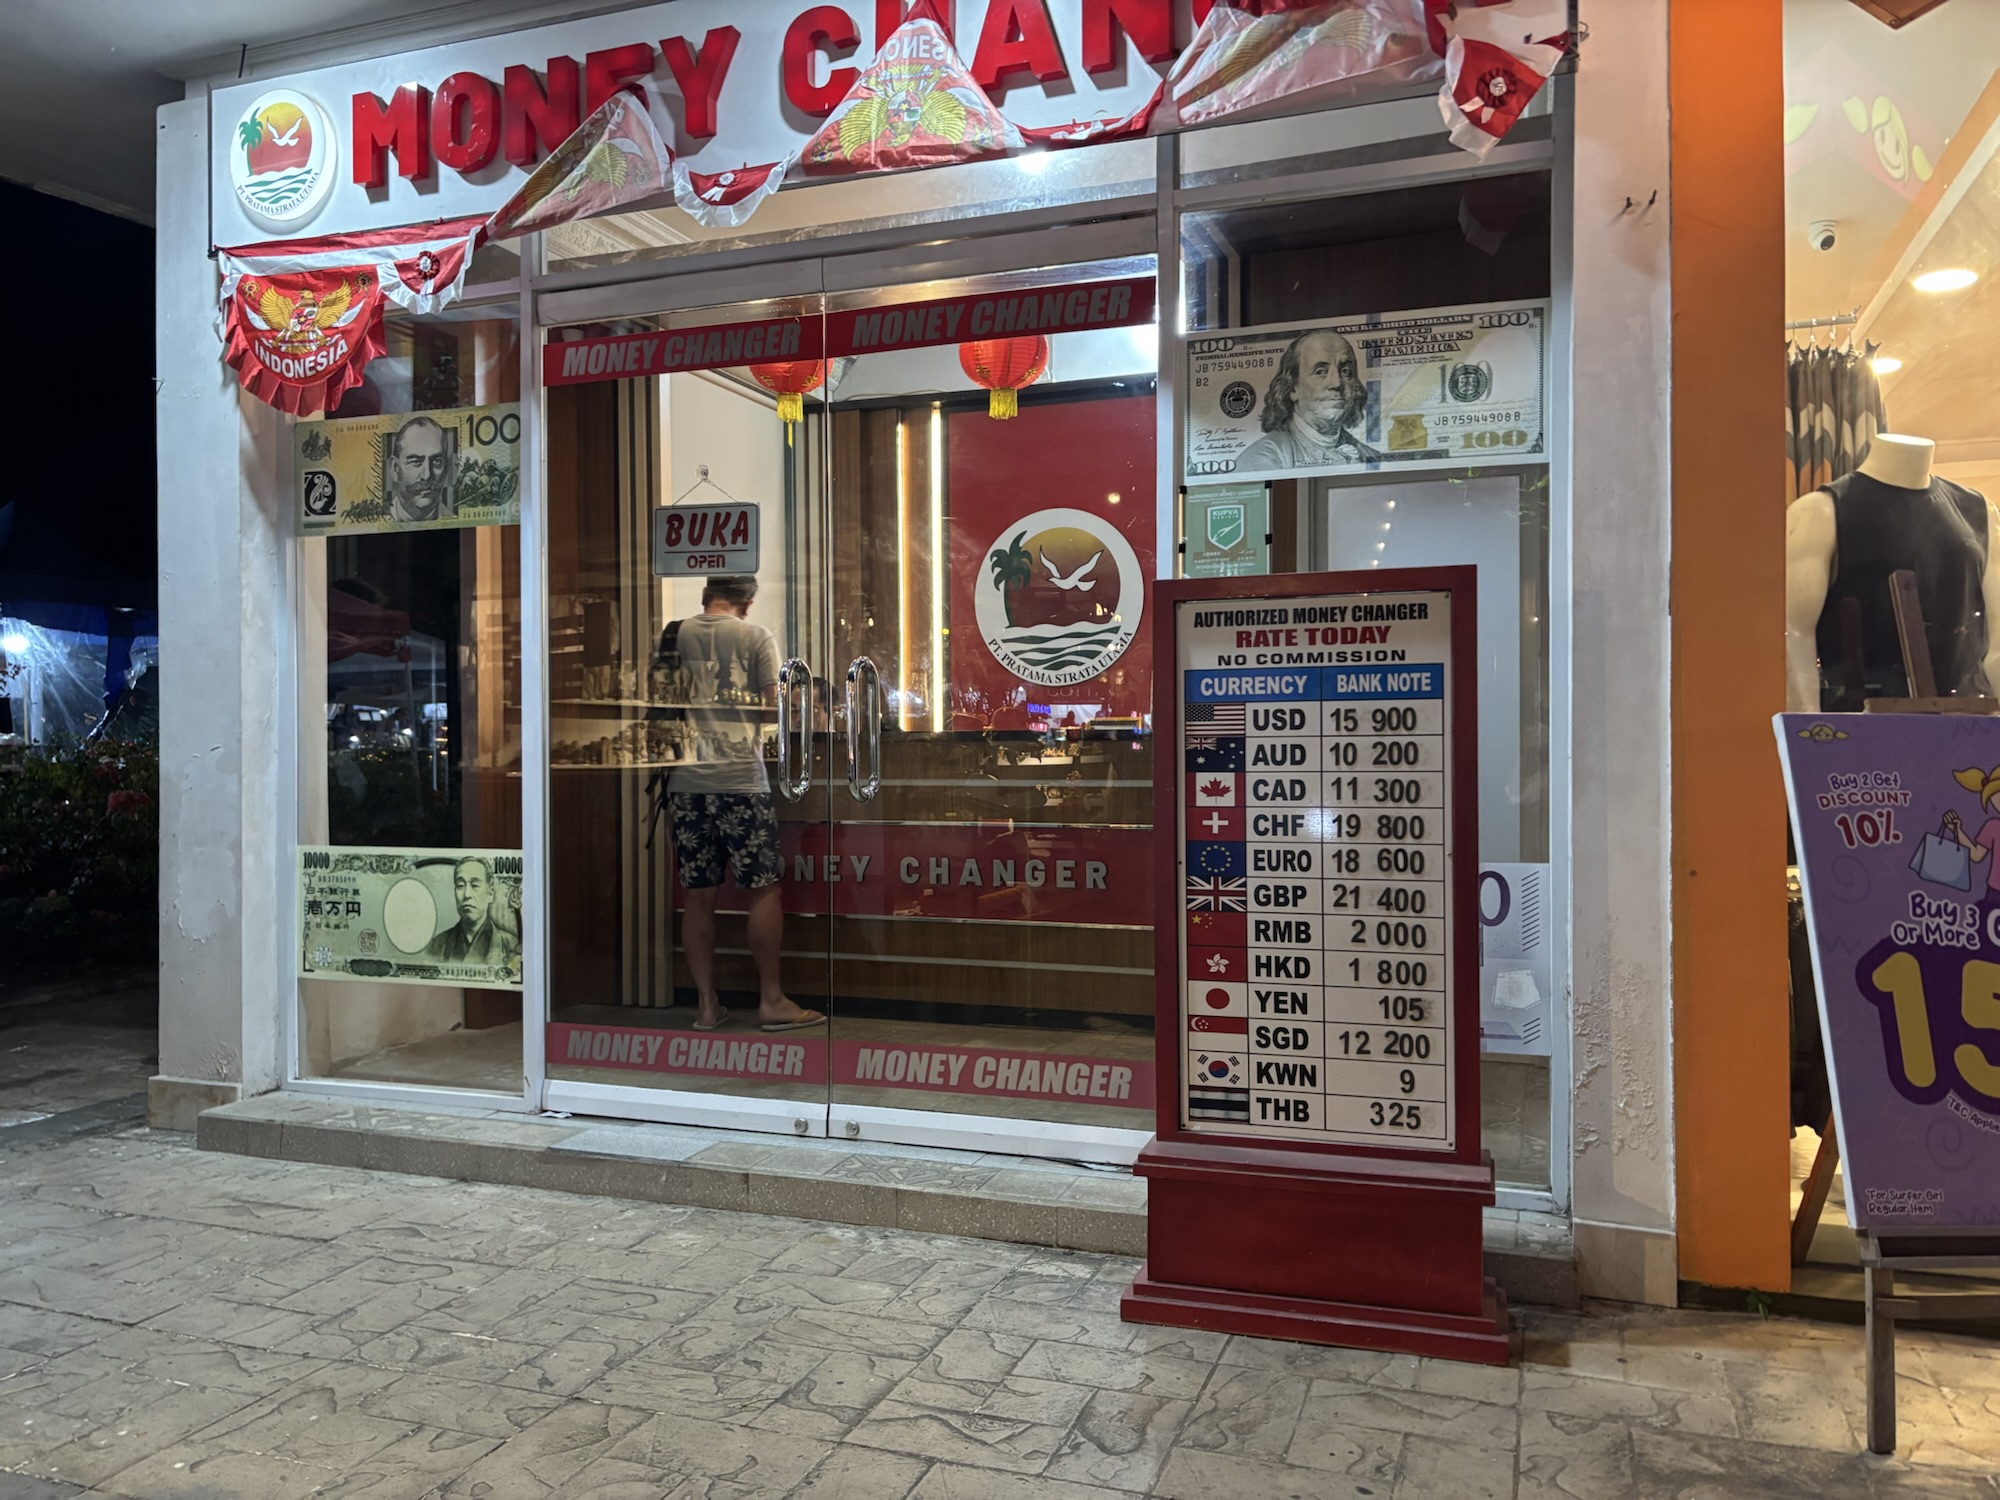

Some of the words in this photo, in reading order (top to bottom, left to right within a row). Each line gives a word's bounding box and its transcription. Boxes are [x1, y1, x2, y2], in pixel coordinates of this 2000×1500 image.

[245, 195, 275, 214] PRATAMA
[275, 198, 301, 214] STRATA
[300, 171, 320, 200] UTAMA
[852, 303, 962, 348] MONEY
[967, 285, 1132, 336] CHANGER
[1479, 312, 1529, 329] 100
[1192, 338, 1235, 354] 100
[1414, 330, 1473, 344] STATES
[254, 338, 348, 379] INDONESIA
[562, 338, 655, 378] MONEY
[663, 323, 800, 368] CHANGER
[1195, 363, 1209, 373] JB
[1211, 358, 1265, 372] 75944908
[1267, 358, 1274, 366] B
[1196, 377, 1209, 387] B2
[466, 413, 520, 447] 100
[1434, 415, 1449, 426] JB
[1451, 412, 1511, 425] 75944908
[1514, 411, 1521, 420] B
[1461, 429, 1528, 450] 100
[1195, 459, 1237, 474] 100
[665, 510, 749, 548] BUKA
[687, 554, 726, 569] OPEN
[1193, 608, 1289, 628] AUTHORIZED
[1293, 605, 1348, 624] MONEY
[1351, 603, 1429, 622] CHANGER
[1236, 629, 1298, 649] RATE
[1304, 625, 1392, 646] TODAY
[988, 638, 1002, 657] PT.
[1001, 655, 1052, 684] PRATAMA
[1055, 664, 1100, 684] STRATA
[1098, 631, 1133, 668] UTAMA
[1218, 654, 1247, 666] NO
[1256, 650, 1406, 665] COMMISSION
[1200, 675, 1308, 696] CURRENCY
[1337, 673, 1382, 693] BANK
[1386, 672, 1432, 692] NOTE
[1252, 708, 1306, 731] USD
[1329, 707, 1358, 732] 15
[1371, 706, 1417, 732] 900
[1252, 744, 1306, 767] AUD
[1329, 742, 1357, 766] 10
[1372, 741, 1419, 765] 200
[1252, 779, 1306, 801] CAD
[1330, 777, 1358, 800] 11
[1374, 778, 1421, 803] 300
[1830, 774, 1858, 790] Buy
[1862, 773, 1870, 786] 2
[1873, 772, 1899, 787] Get
[1818, 791, 1910, 809] DISCOUNT
[1253, 814, 1305, 837] CHF
[1332, 814, 1361, 838] 19
[1377, 814, 1425, 840] 800
[1836, 809, 1901, 847] 10%
[303, 852, 330, 869] 10000
[494, 856, 522, 875] 10000
[777, 855, 870, 882] NEY
[900, 856, 1109, 890] CHANGER
[1253, 849, 1312, 872] EURO
[1331, 849, 1360, 873] 18
[1377, 848, 1425, 875] 600
[1254, 884, 1307, 907] GBP
[1332, 884, 1360, 909] 21
[1377, 887, 1426, 913] 400
[1910, 893, 1959, 926] Buy
[1966, 906, 1979, 928] 3
[1254, 920, 1311, 943] RMB
[1351, 920, 1366, 943] 2
[1376, 921, 1427, 948] 000
[1893, 923, 1918, 943] Or
[1924, 922, 1978, 946] More
[1255, 955, 1311, 979] HKD
[1349, 958, 1360, 981] 1
[1377, 960, 1427, 986] 800
[1255, 990, 1308, 1014] YEN
[1379, 996, 1424, 1021] 105
[567, 1030, 662, 1064] MONEY
[668, 1036, 806, 1076] CHANGER
[1256, 1026, 1309, 1050] SGD
[1339, 1031, 1371, 1055] 12
[1384, 1031, 1430, 1058] 200
[856, 1047, 967, 1086] MONEY
[973, 1055, 1132, 1100] CHANGER
[1256, 1062, 1317, 1087] KWN
[1400, 1069, 1415, 1093] 9
[1256, 1097, 1310, 1122] THB
[1370, 1102, 1421, 1129] 325
[1868, 1203, 1909, 1214] Regular
[1911, 1203, 1934, 1214] Item
[1889, 1190, 1923, 1201] Surfer
[1926, 1190, 1943, 1200] Girl
